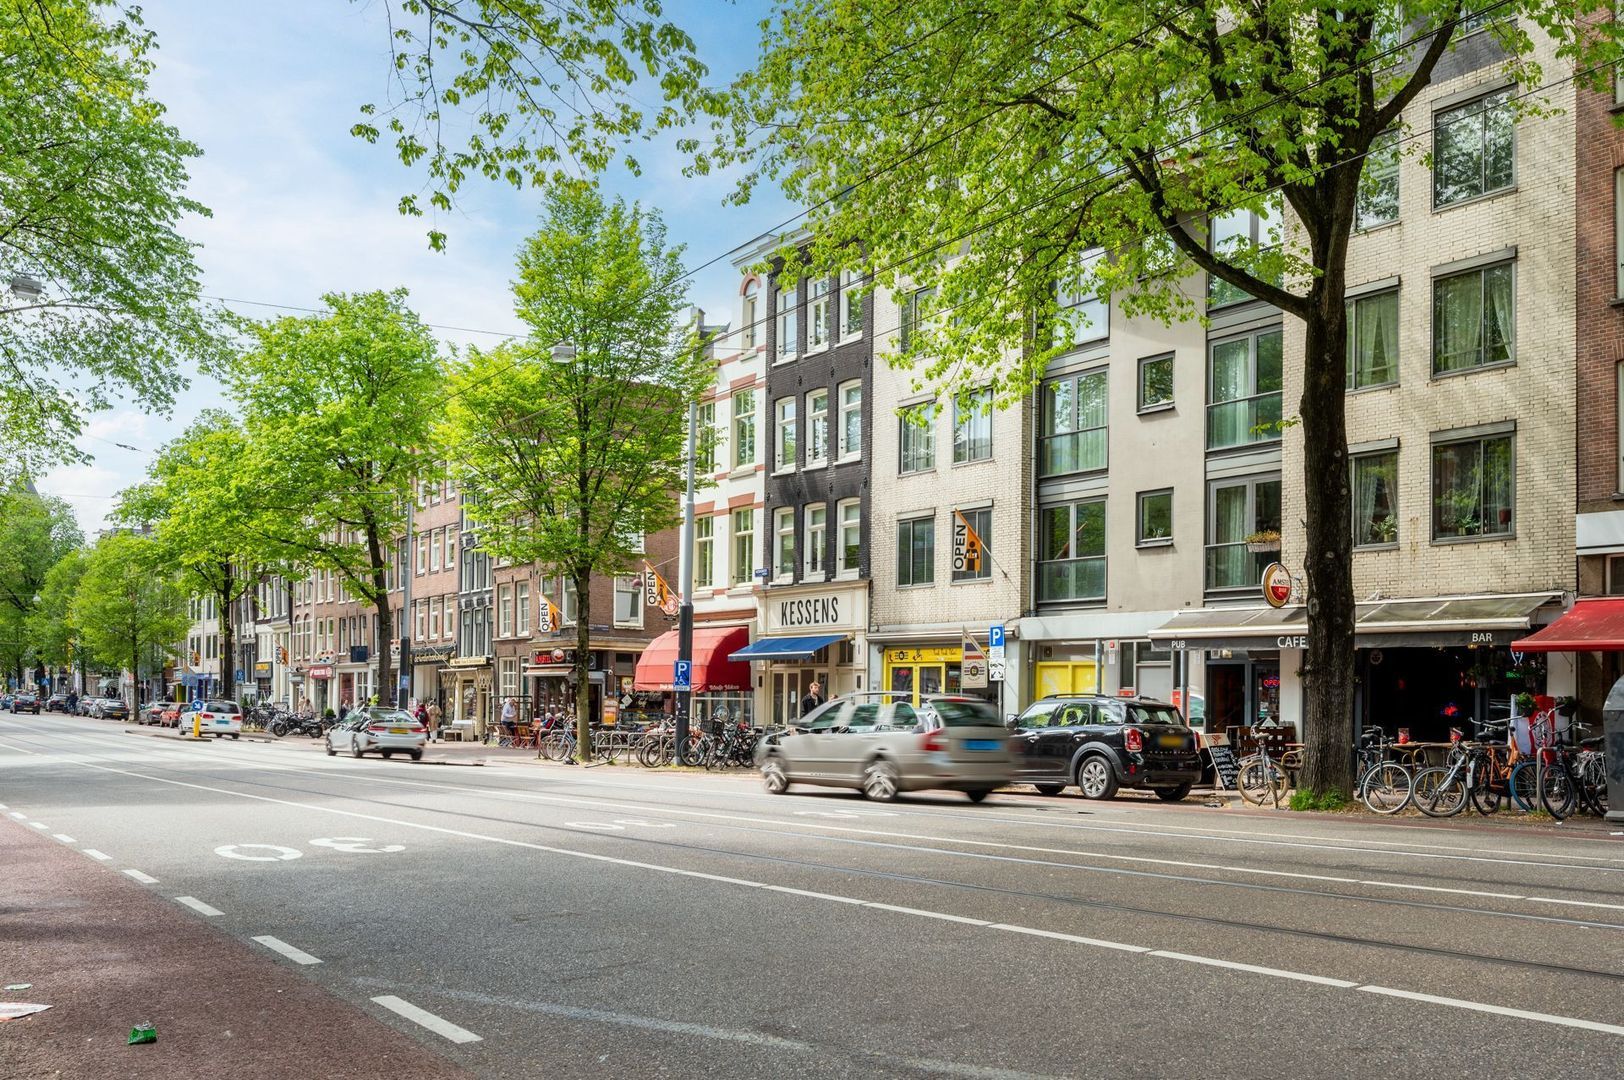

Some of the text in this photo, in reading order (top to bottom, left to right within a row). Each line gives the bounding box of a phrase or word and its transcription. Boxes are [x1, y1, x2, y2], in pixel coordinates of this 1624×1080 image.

[953, 525, 966, 569] OPEN
[648, 572, 656, 604] OPEN
[541, 603, 549, 631] OPEN
[781, 597, 838, 625] KESSENS
[992, 628, 1001, 645] P
[1171, 640, 1186, 648] PUB
[1277, 636, 1306, 648] CAFE
[1472, 633, 1492, 642] BAR
[678, 663, 687, 675] P
